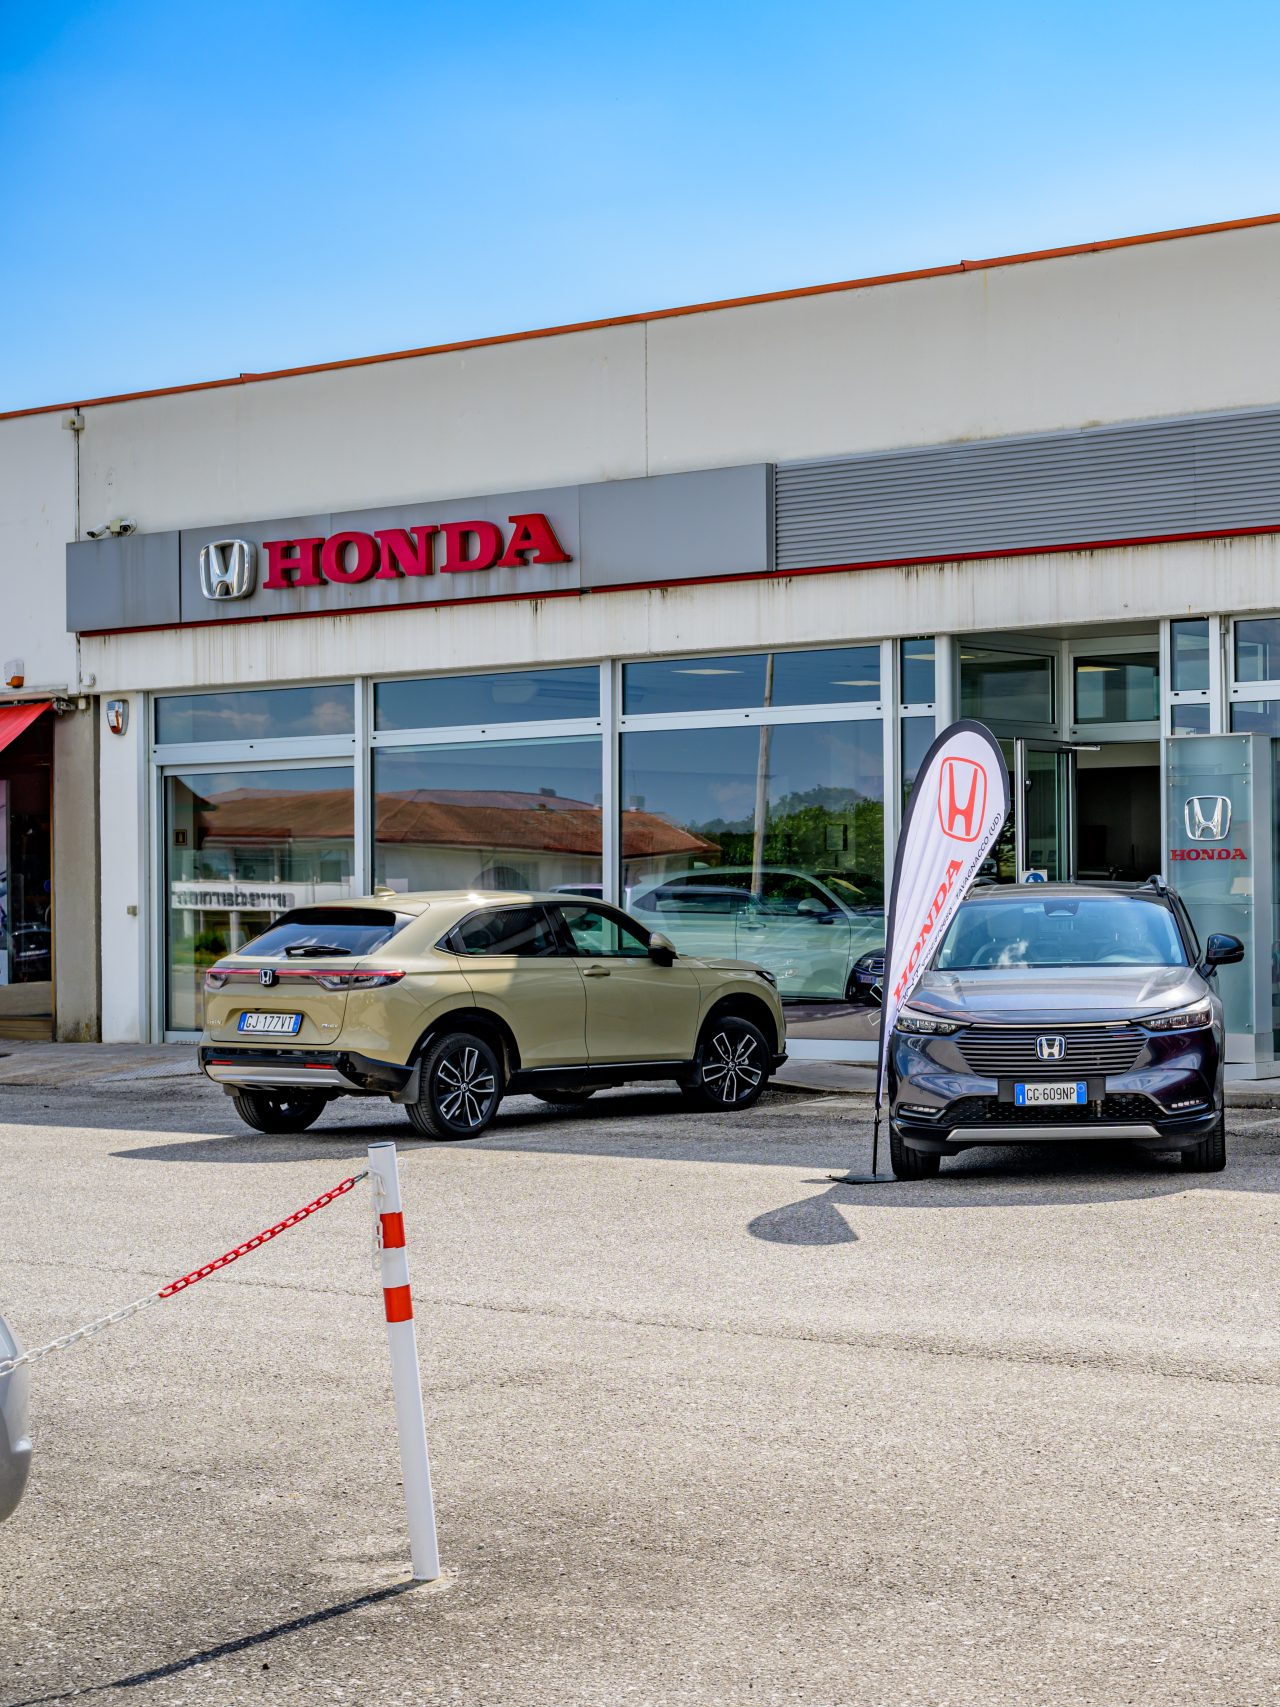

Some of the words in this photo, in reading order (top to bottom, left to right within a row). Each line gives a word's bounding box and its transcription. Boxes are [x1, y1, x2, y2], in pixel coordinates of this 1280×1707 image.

[263, 513, 573, 589] HONDA
[956, 836, 990, 900] TAVAGNACCO
[988, 813, 1002, 837] (UD)
[1170, 848, 1248, 861] HONDA
[893, 859, 965, 1007] HONDA
